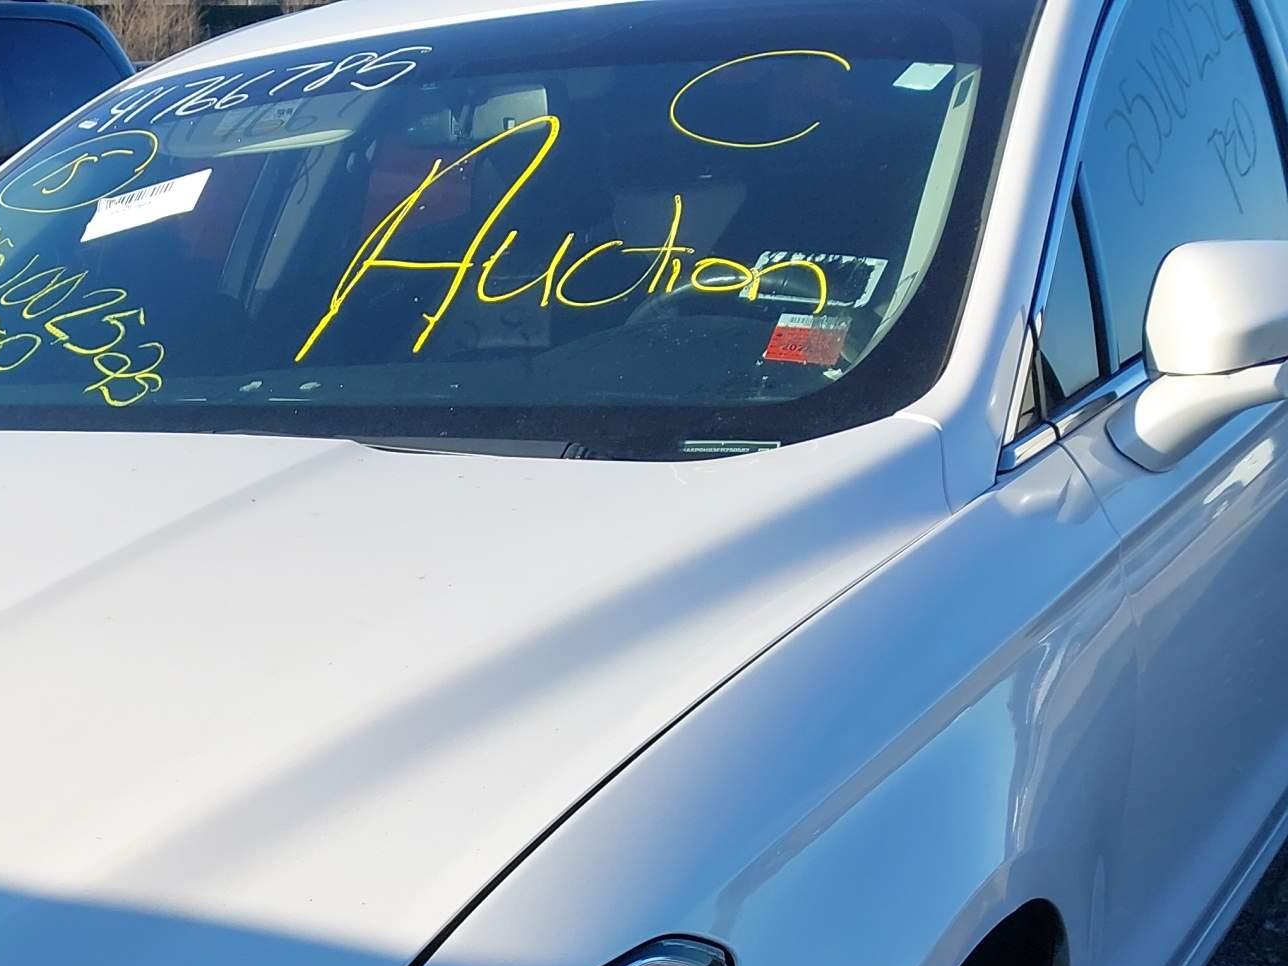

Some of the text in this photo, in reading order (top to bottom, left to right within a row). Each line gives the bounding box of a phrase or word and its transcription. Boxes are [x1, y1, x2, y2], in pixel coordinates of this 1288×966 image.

[97, 46, 432, 133] 41766785
[669, 49, 851, 149] C
[295, 114, 827, 363] Auction
